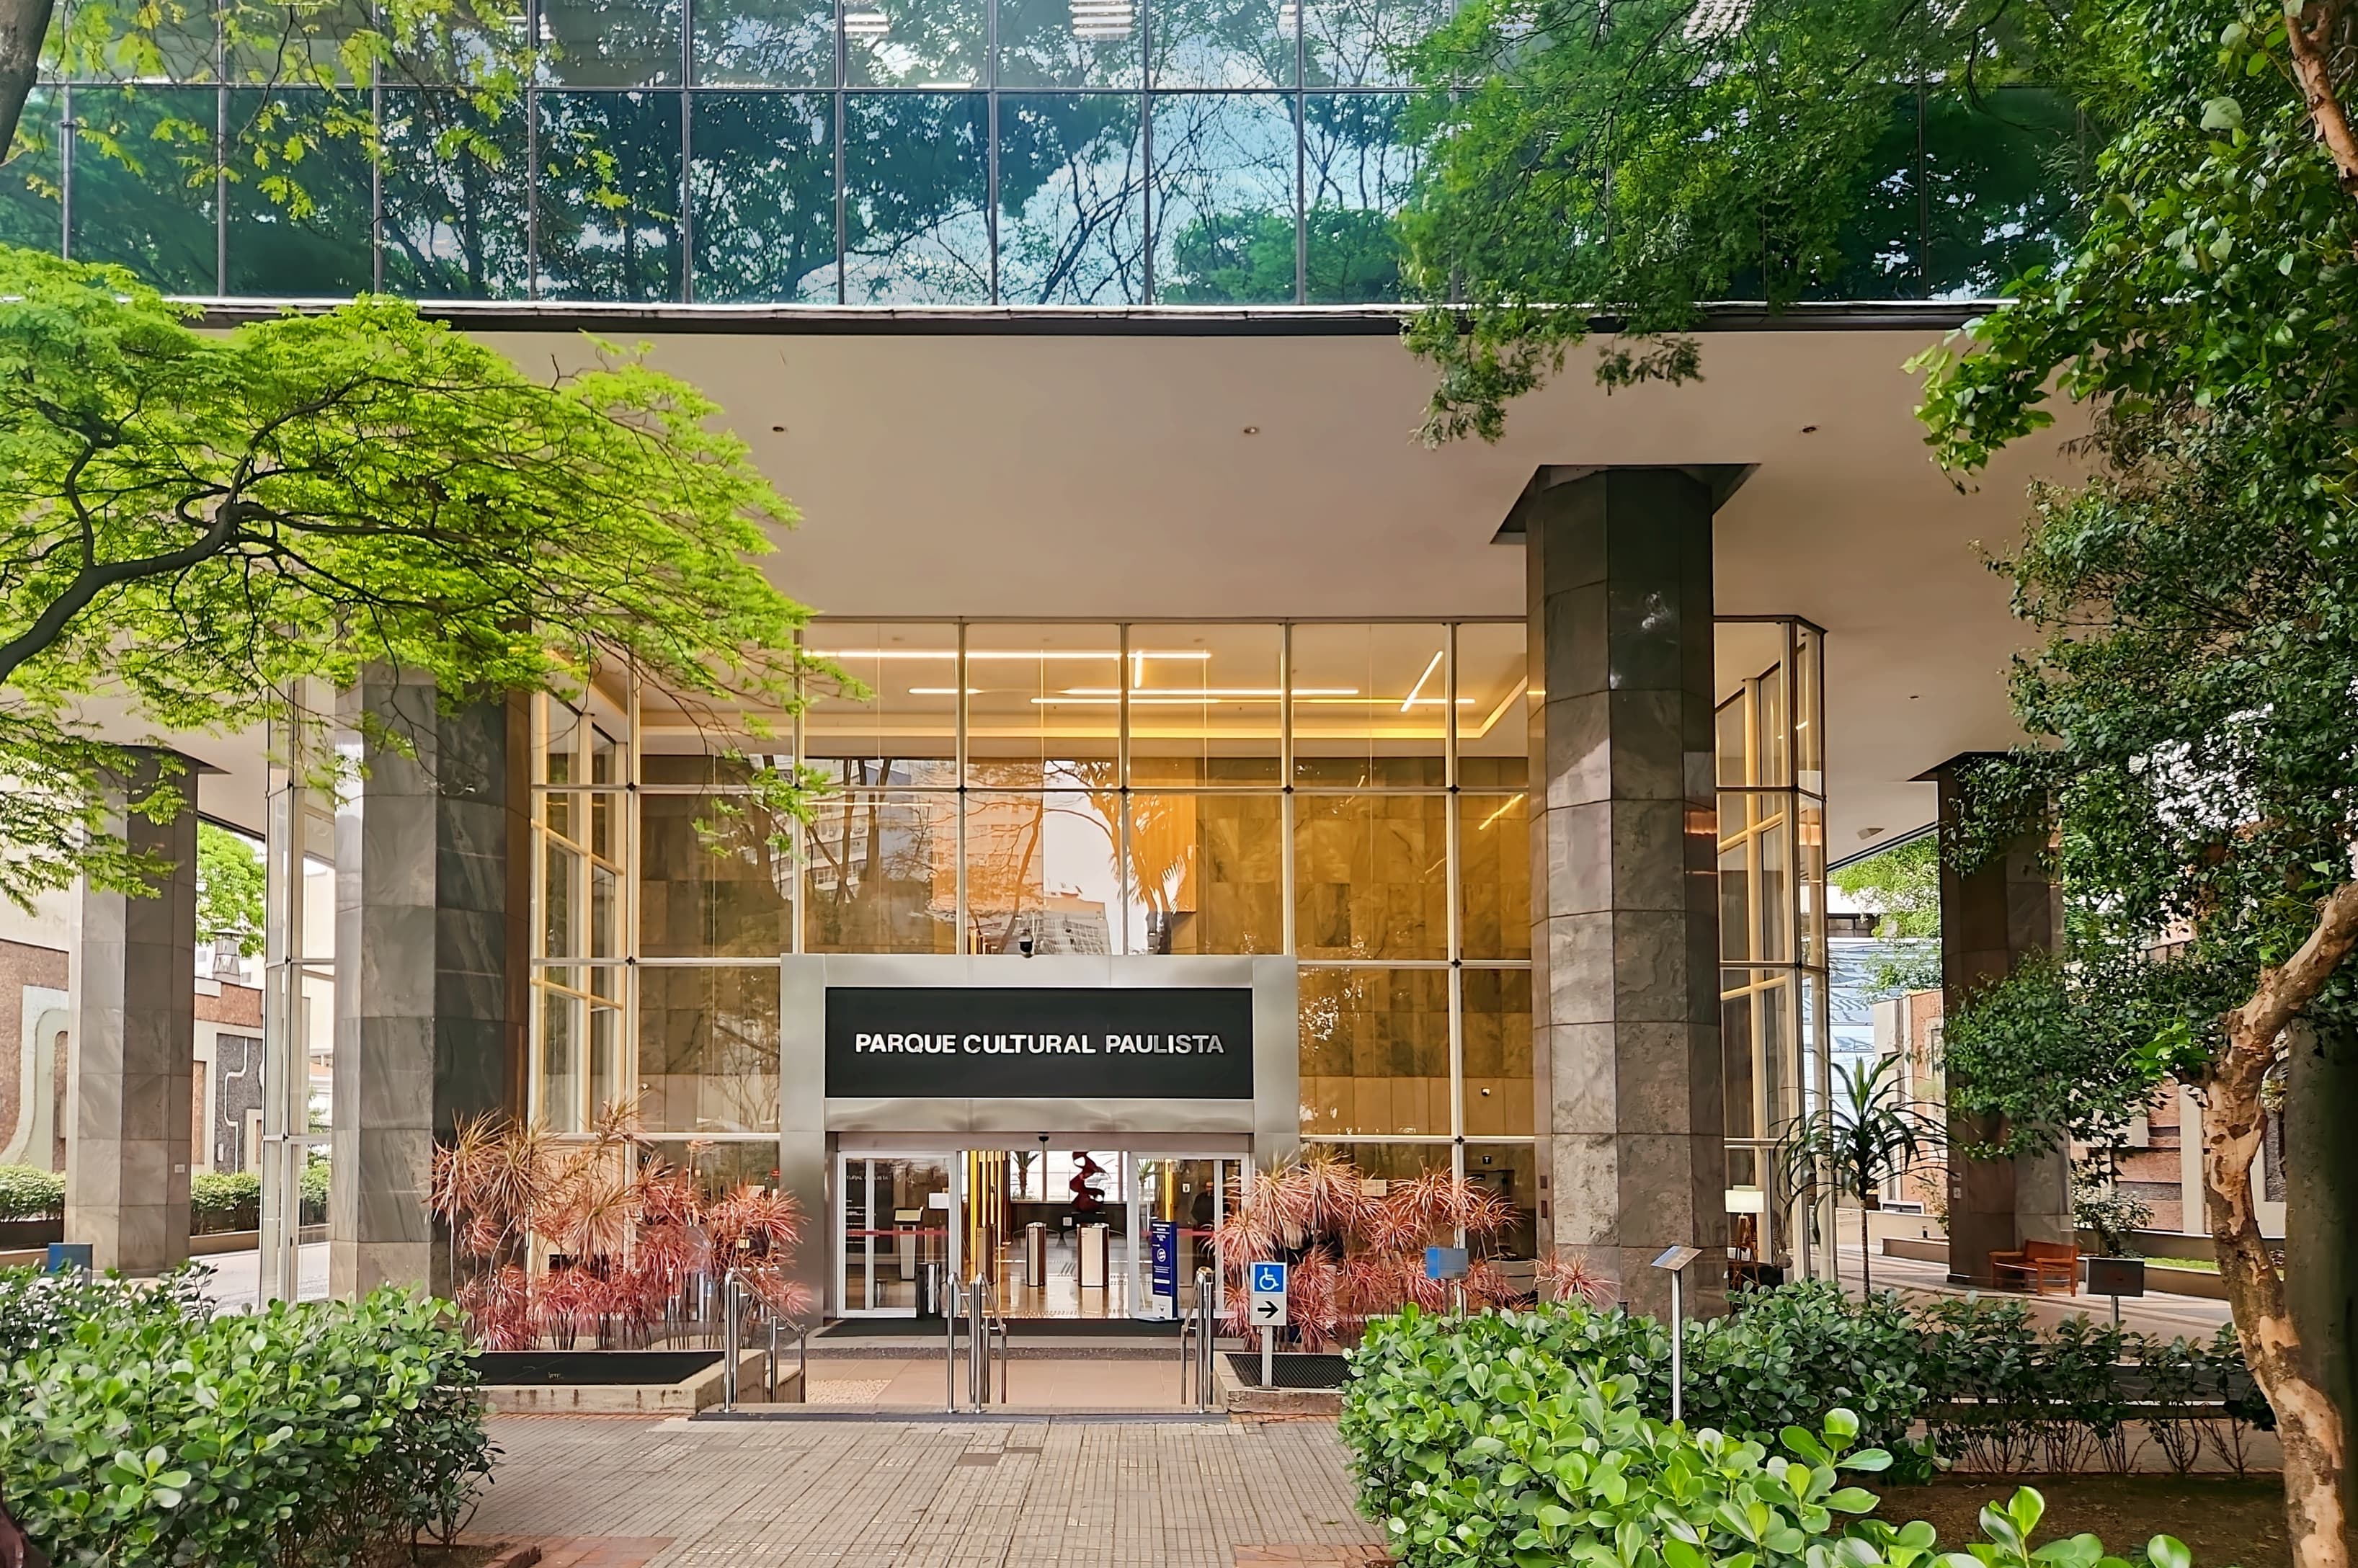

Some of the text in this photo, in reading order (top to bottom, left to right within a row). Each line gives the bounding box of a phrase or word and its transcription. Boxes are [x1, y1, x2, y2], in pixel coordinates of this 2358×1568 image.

[855, 1033, 1224, 1054] PARQUE CULTURAL PAULISTA
